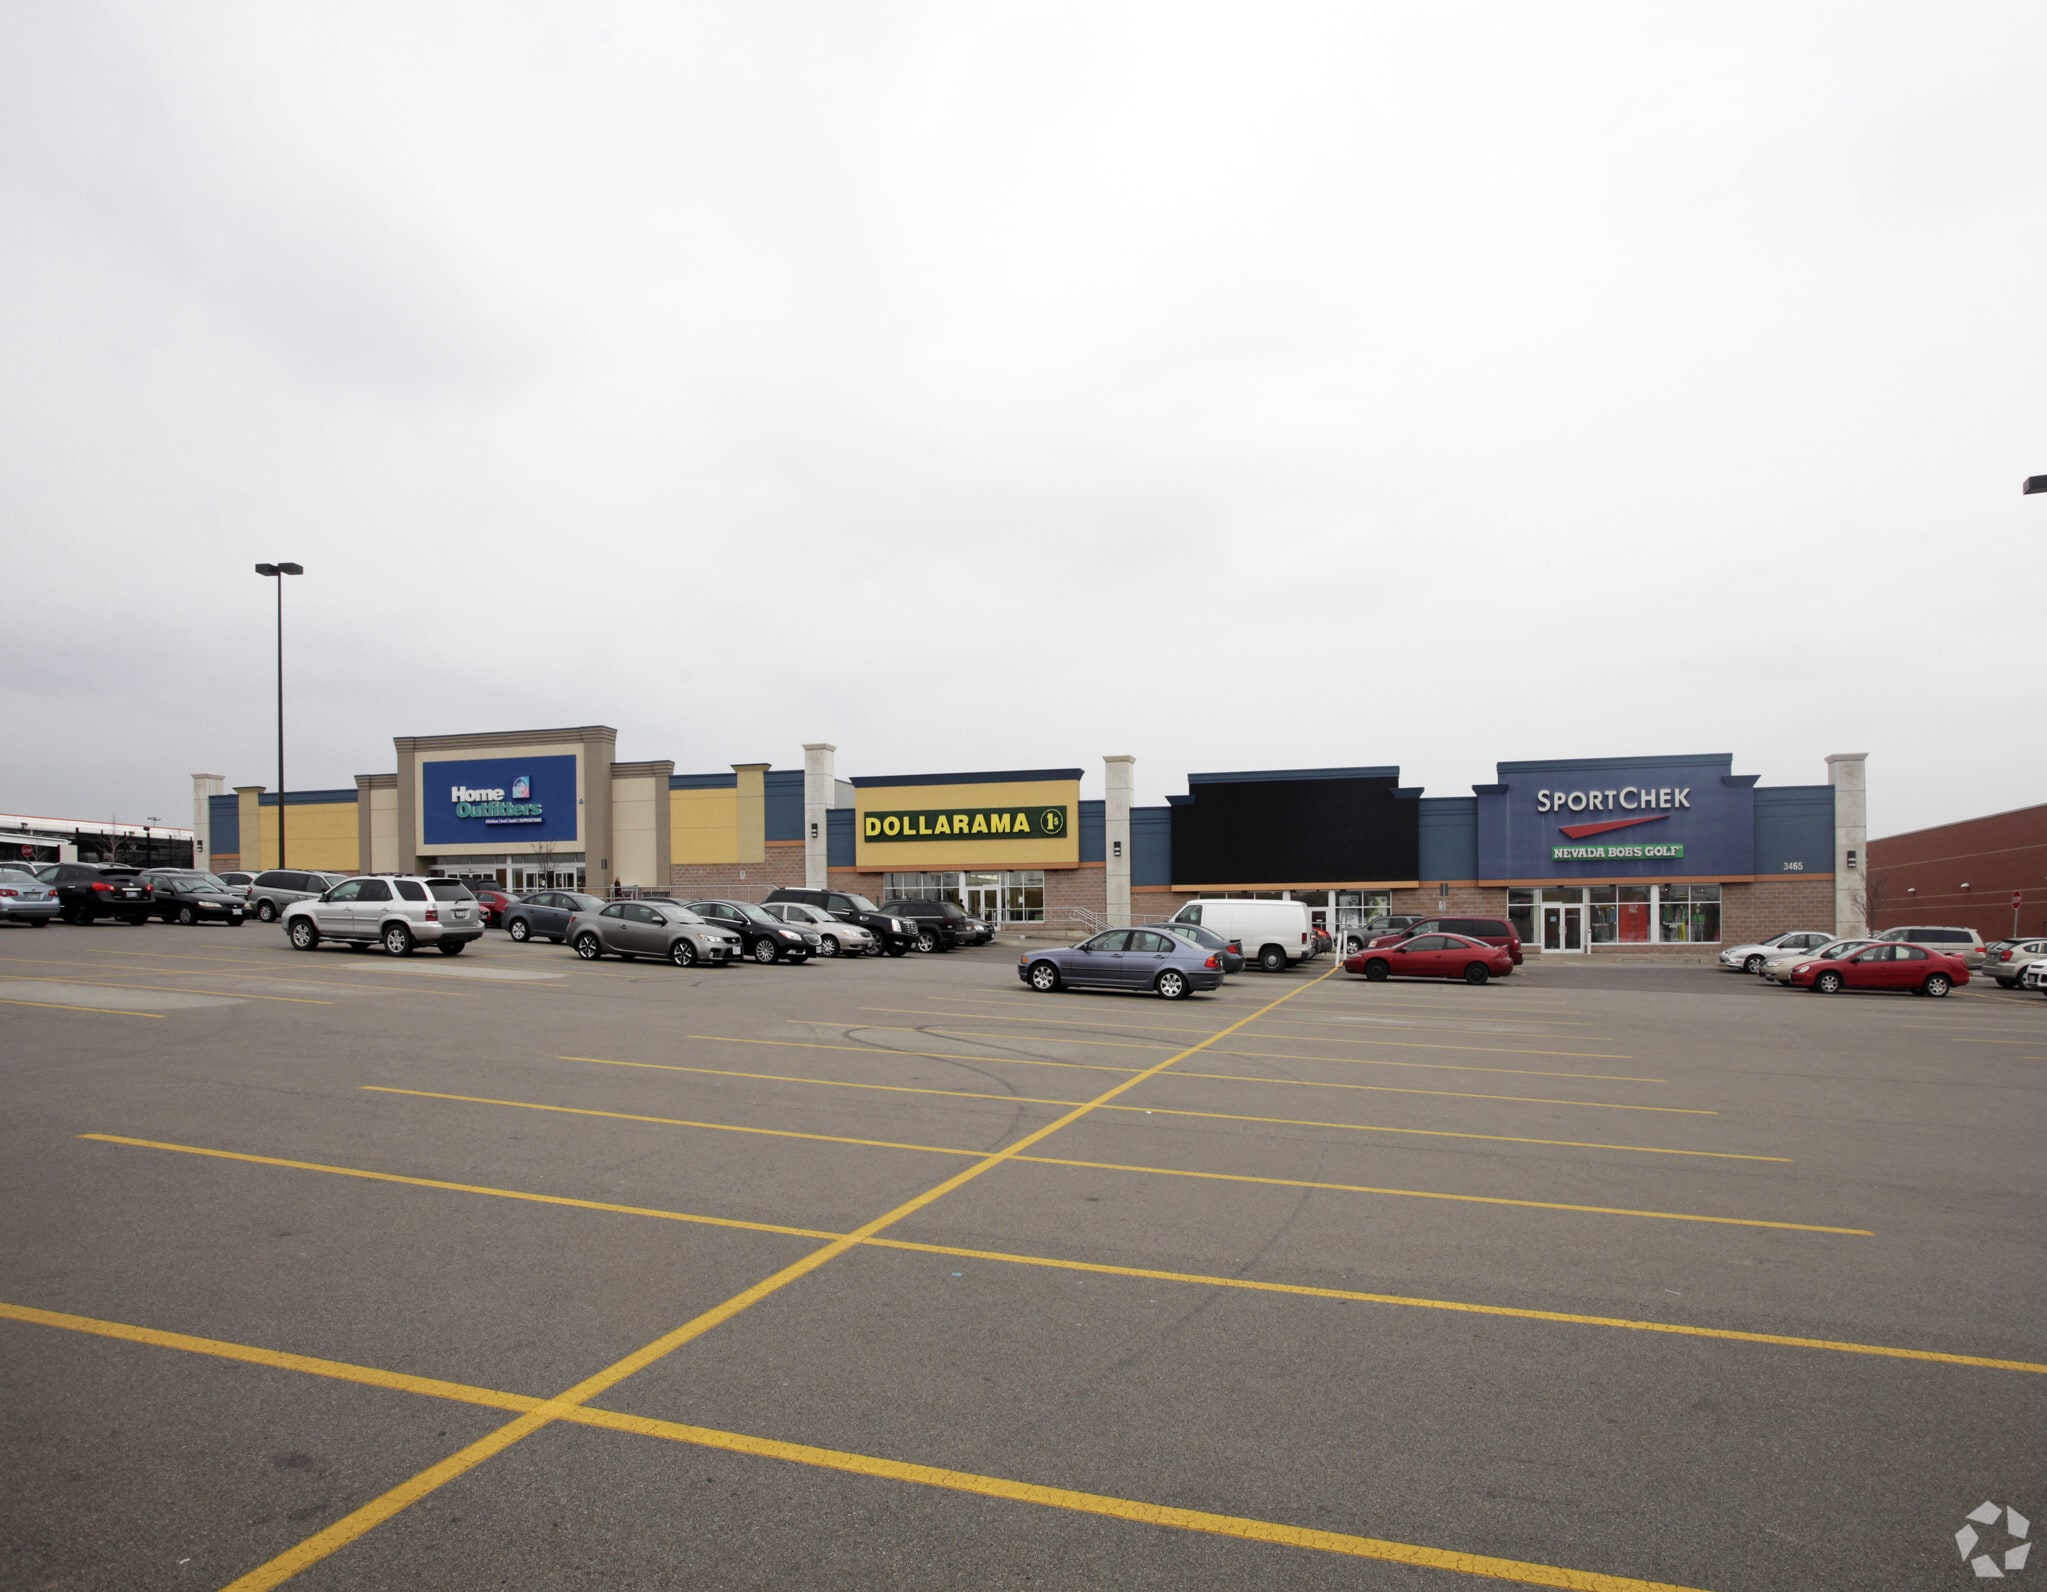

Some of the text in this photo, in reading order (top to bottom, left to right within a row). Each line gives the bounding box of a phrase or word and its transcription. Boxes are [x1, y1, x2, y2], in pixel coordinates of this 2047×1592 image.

[451, 786, 505, 802] Home
[456, 801, 542, 818] Outfitters
[865, 813, 1030, 836] DOLLARAMA
[1554, 847, 1605, 858] NEVADA
[1783, 861, 1804, 871] 3465
